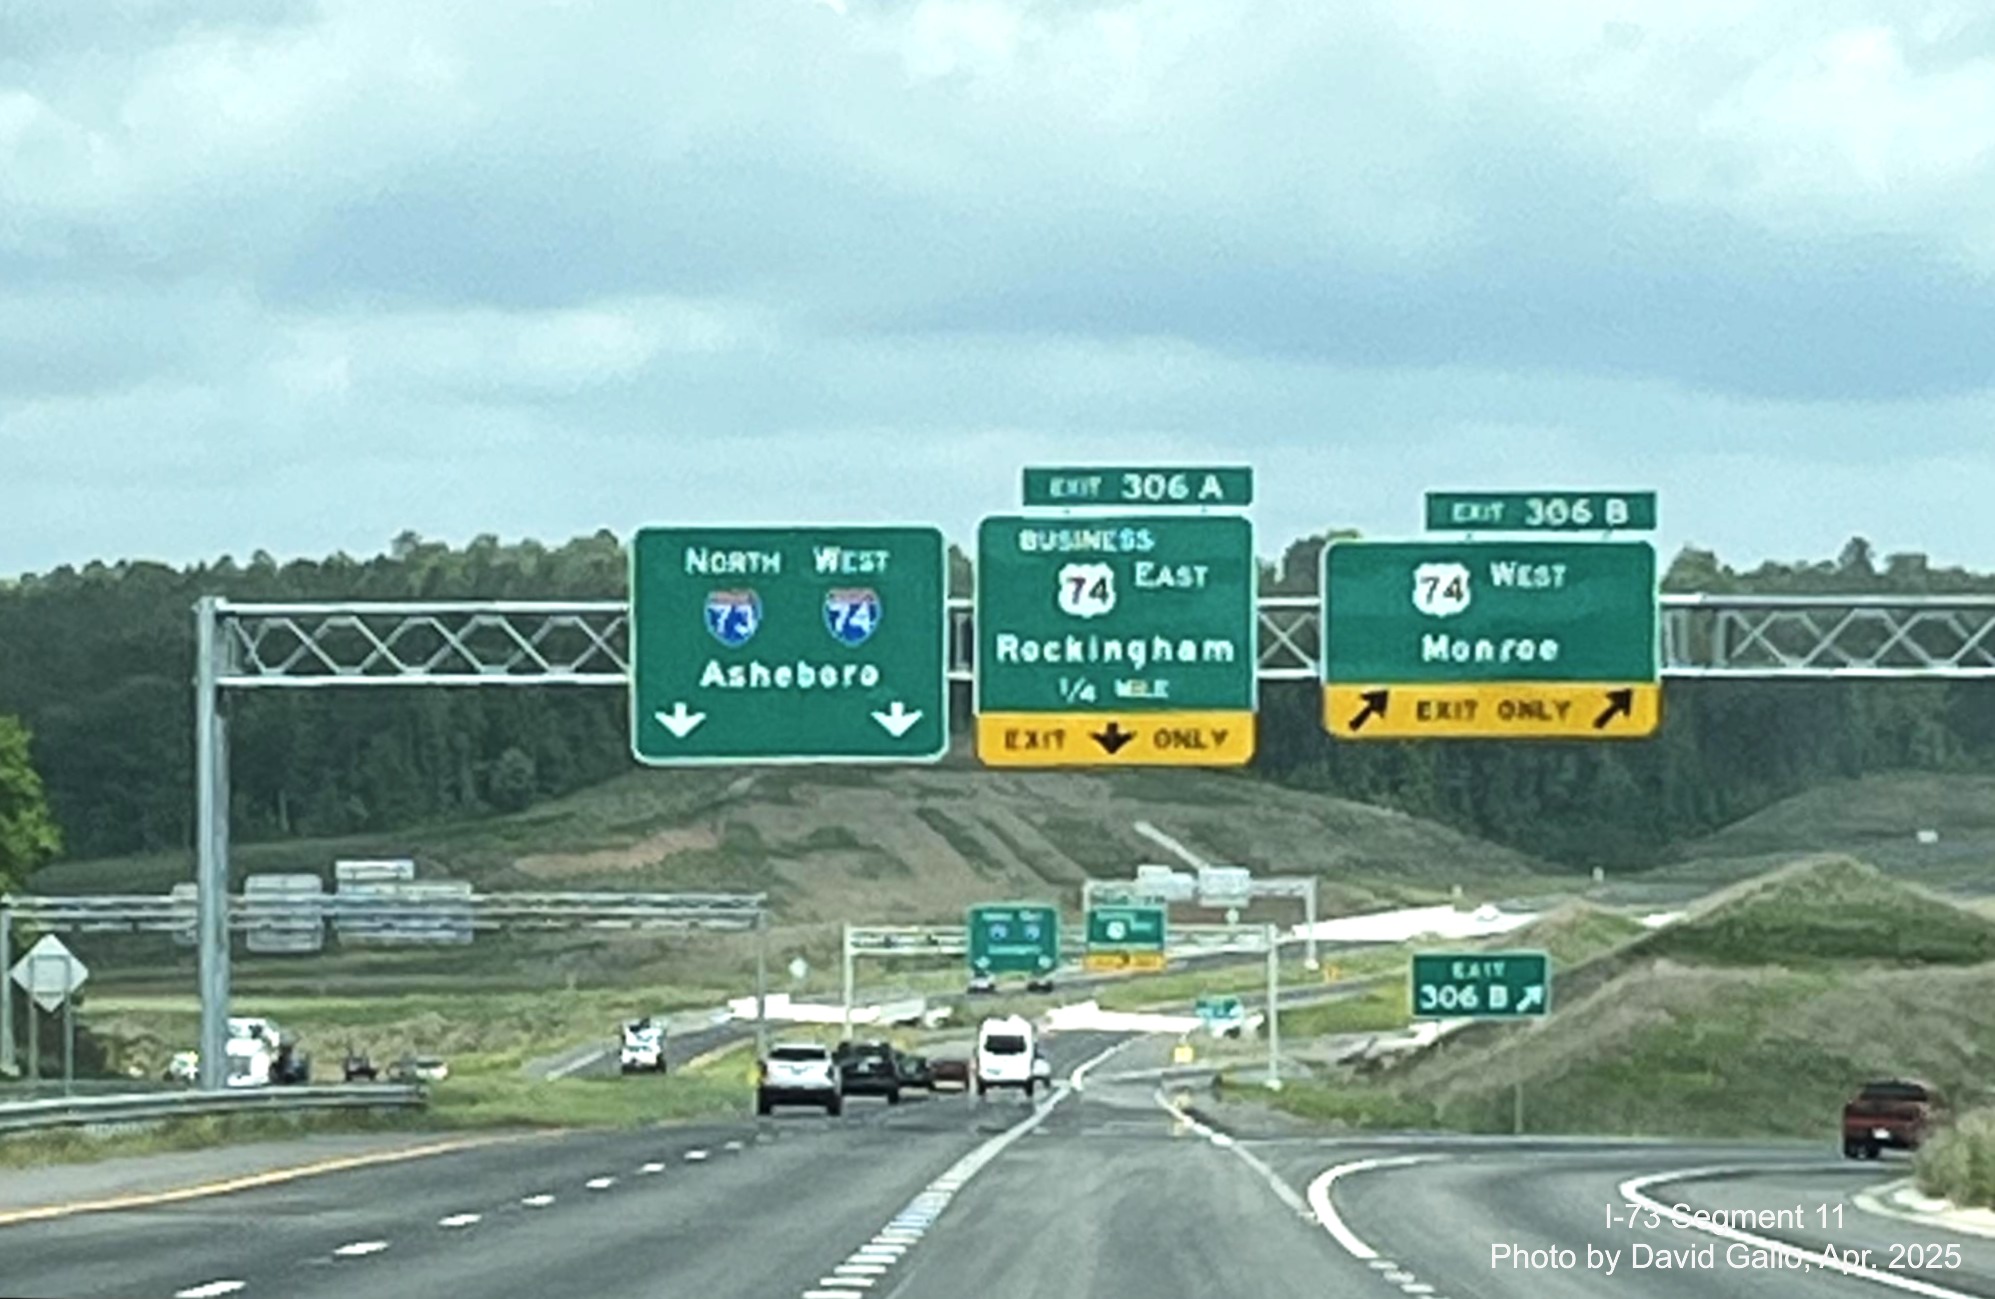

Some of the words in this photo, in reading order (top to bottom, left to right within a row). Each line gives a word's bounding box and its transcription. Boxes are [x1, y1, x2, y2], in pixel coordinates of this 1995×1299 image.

[1050, 476, 1102, 498] EXIT
[1122, 473, 1190, 499] 306
[1198, 473, 1224, 499] A
[1453, 502, 1504, 523] EXIT
[1525, 498, 1593, 526] 306
[1605, 498, 1629, 525] B
[1018, 528, 1156, 551] BUSINESS
[685, 547, 782, 574] NORTH
[813, 546, 890, 574] WEST
[1135, 561, 1209, 588] EAST
[1490, 561, 1567, 588] WEST
[1068, 576, 1109, 605] 74
[1420, 575, 1465, 604] 74
[706, 603, 755, 635] 73
[828, 602, 873, 633] 74
[996, 633, 1235, 671] Rockingham
[1421, 634, 1559, 662] Monroe
[699, 659, 880, 688] Asheboro
[1114, 679, 1170, 698] MILE
[1416, 700, 1479, 722] EXIT
[1497, 700, 1571, 722] ONLY
[1004, 728, 1067, 751] EXIT
[1153, 728, 1229, 751] ONLY
[1419, 983, 1480, 1010] 306
[1488, 984, 1509, 1010] B
